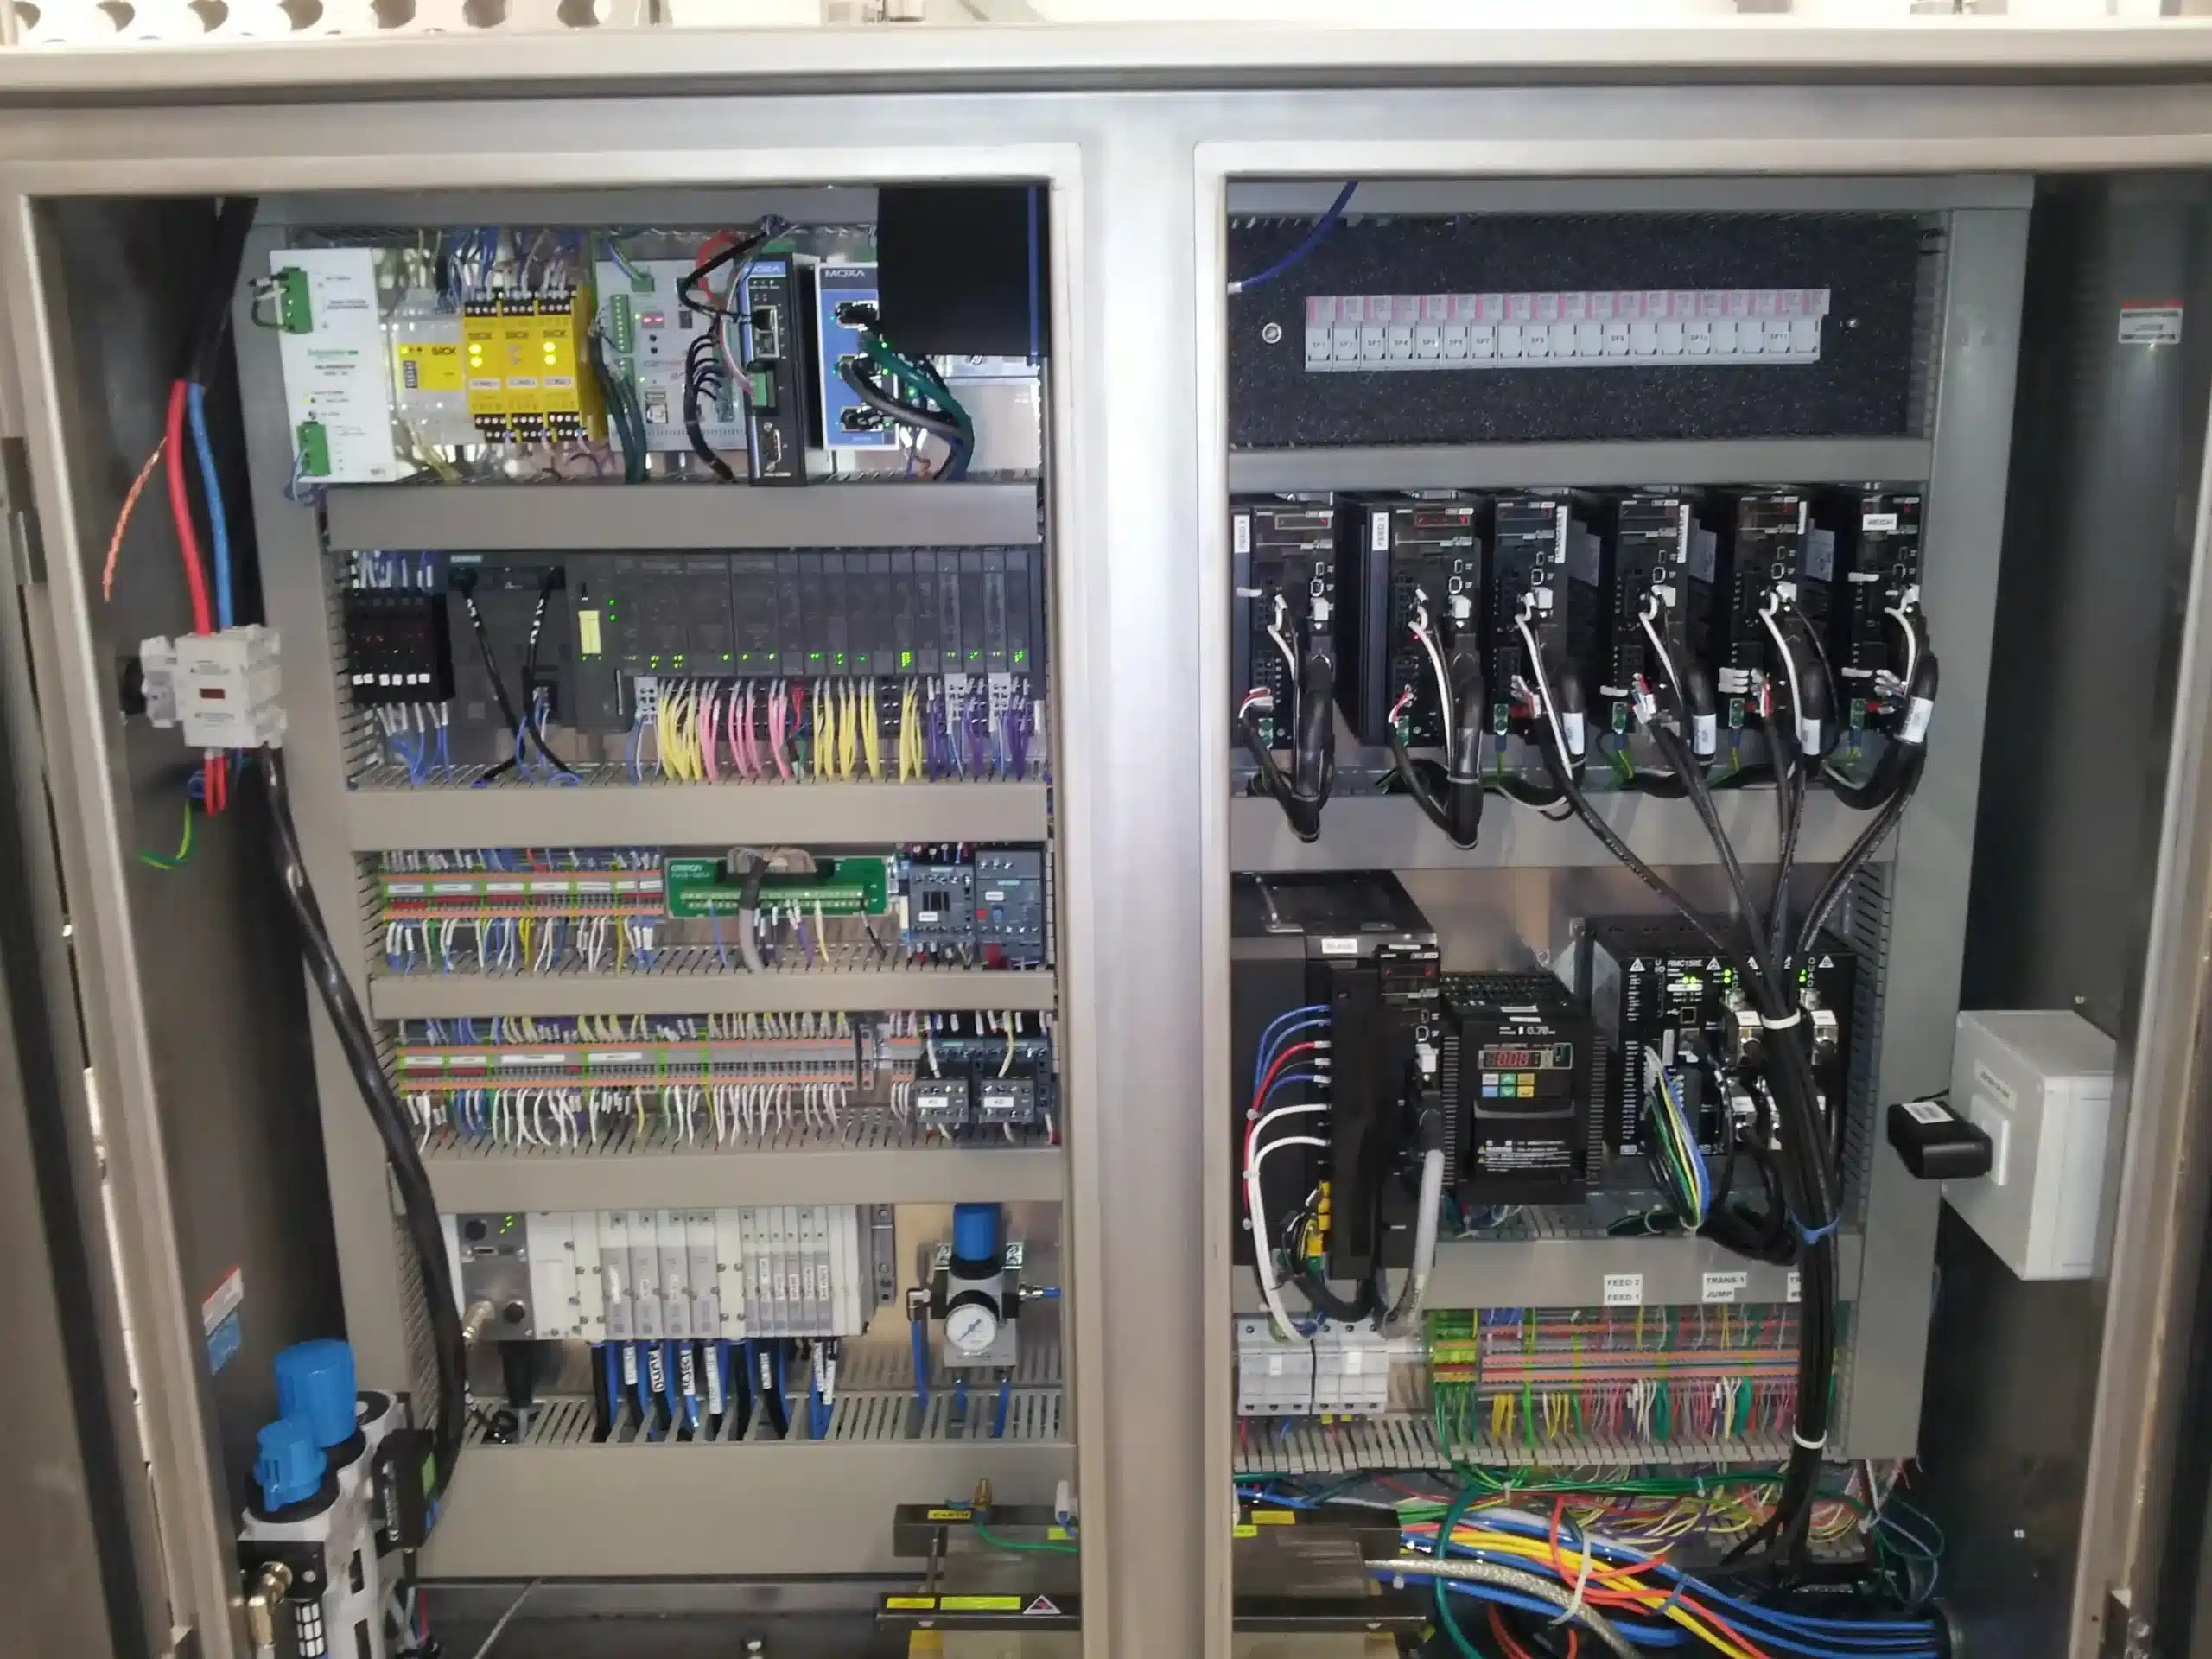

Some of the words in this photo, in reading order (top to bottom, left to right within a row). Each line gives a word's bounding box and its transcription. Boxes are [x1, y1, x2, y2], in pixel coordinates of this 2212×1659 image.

[825, 269, 865, 277] MOXA
[543, 329, 566, 338] SICK
[432, 346, 456, 356] SICK
[1707, 1276, 1738, 1285] TRANS
[1706, 1290, 1732, 1299] JUMP
